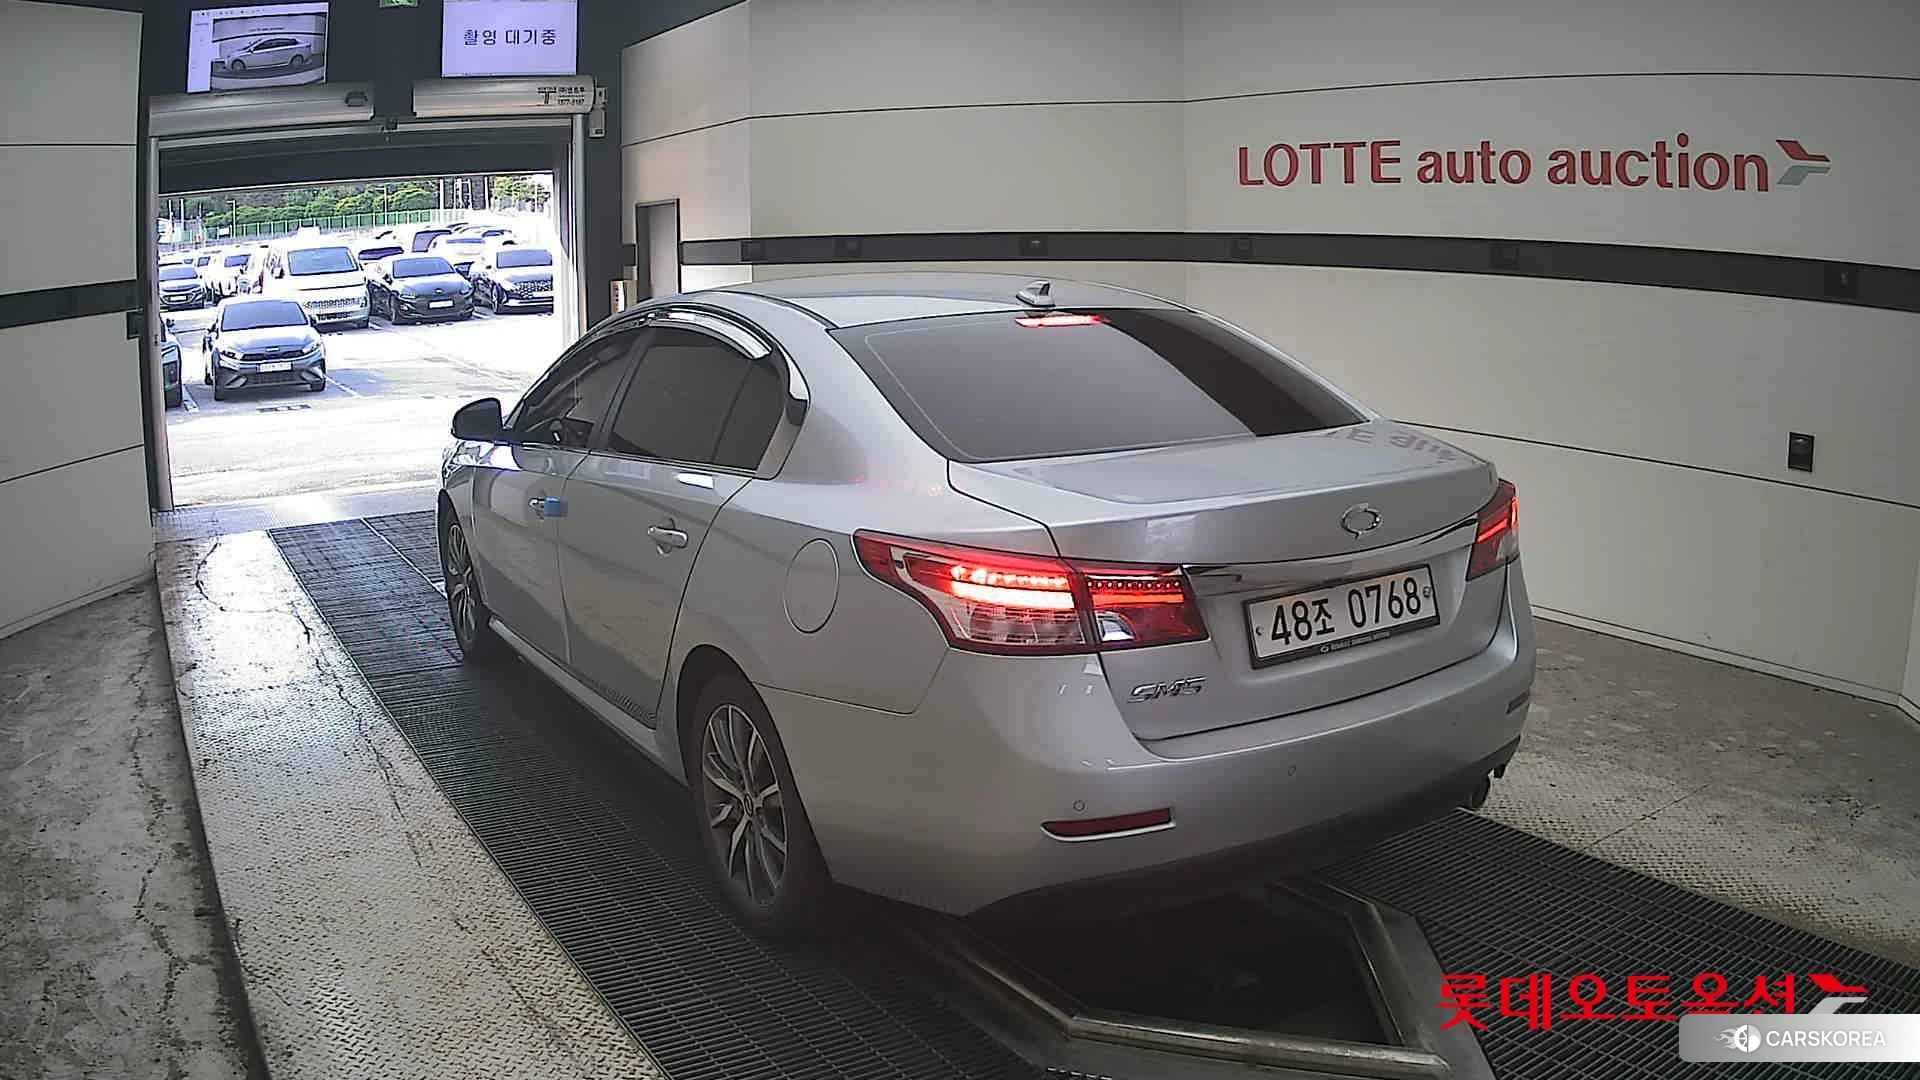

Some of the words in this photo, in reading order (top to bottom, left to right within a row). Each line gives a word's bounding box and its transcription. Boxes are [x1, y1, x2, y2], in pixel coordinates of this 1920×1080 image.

[463, 29, 497, 46] 촬영
[505, 29, 556, 46] 대기중
[1238, 140, 1401, 187] LOTTE
[1416, 140, 1532, 184] auto
[1547, 132, 1769, 192] auction
[1271, 598, 1335, 645] 48조
[1348, 577, 1421, 628] 0768
[1127, 676, 1207, 703] SM5
